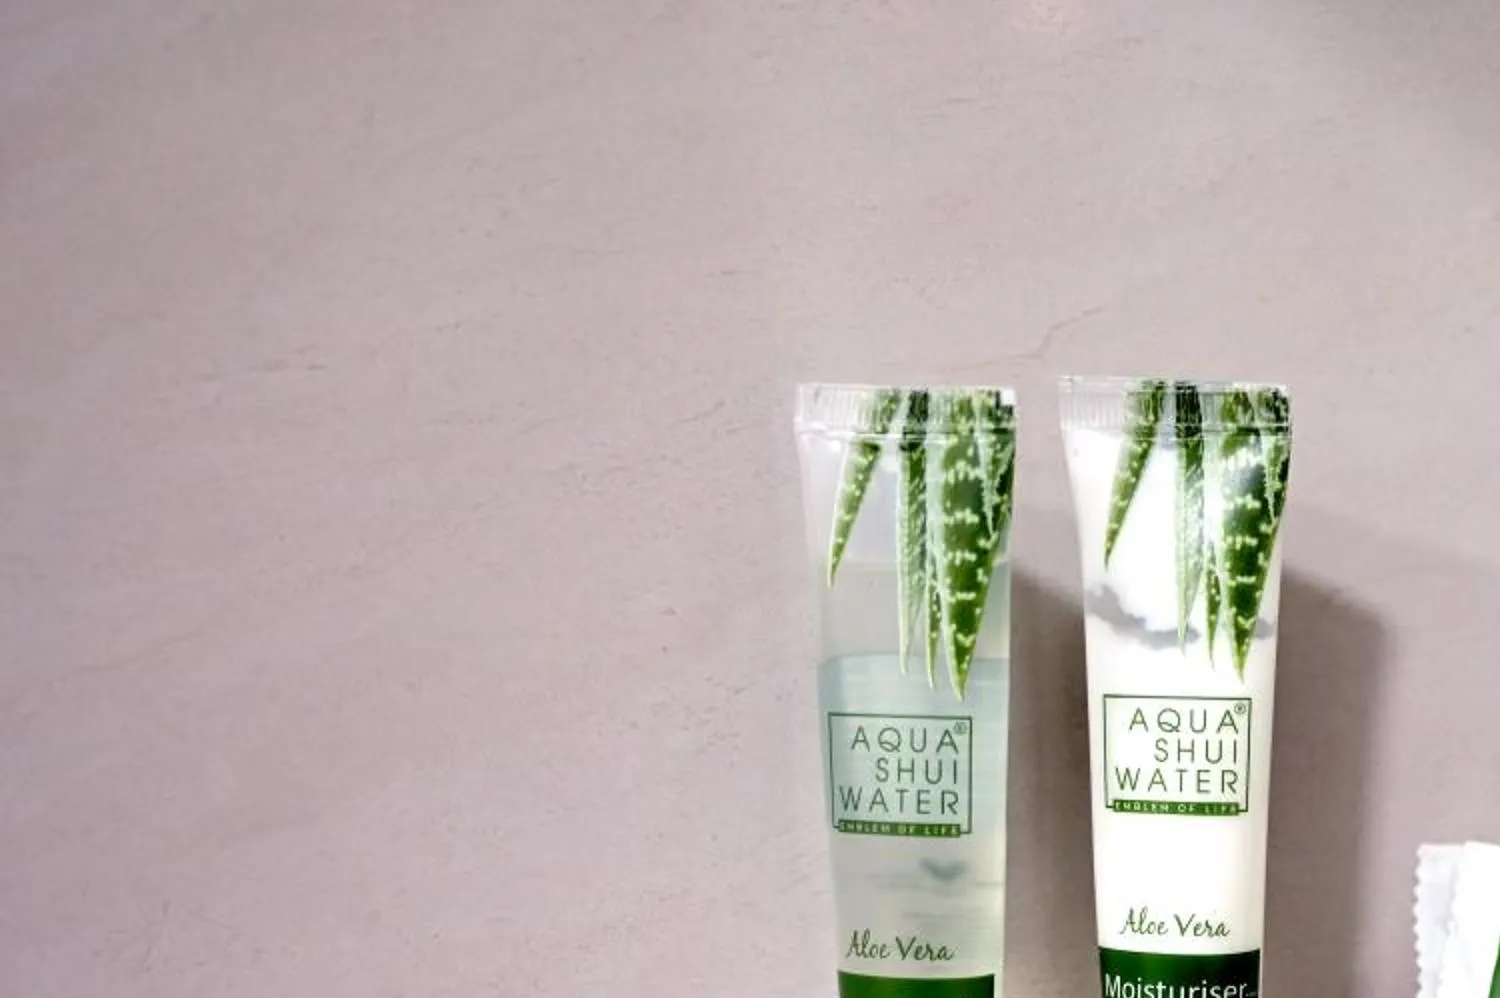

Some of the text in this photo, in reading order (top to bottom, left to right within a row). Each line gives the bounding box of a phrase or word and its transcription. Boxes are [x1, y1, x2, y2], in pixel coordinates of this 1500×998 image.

[1154, 737, 1237, 764] SHUI
[875, 757, 957, 785] SHUI
[1115, 767, 1239, 794] WATER
[839, 785, 959, 815] WATER
[1119, 906, 1231, 938] Aloe Vera
[846, 928, 956, 962] Aloe Vera
